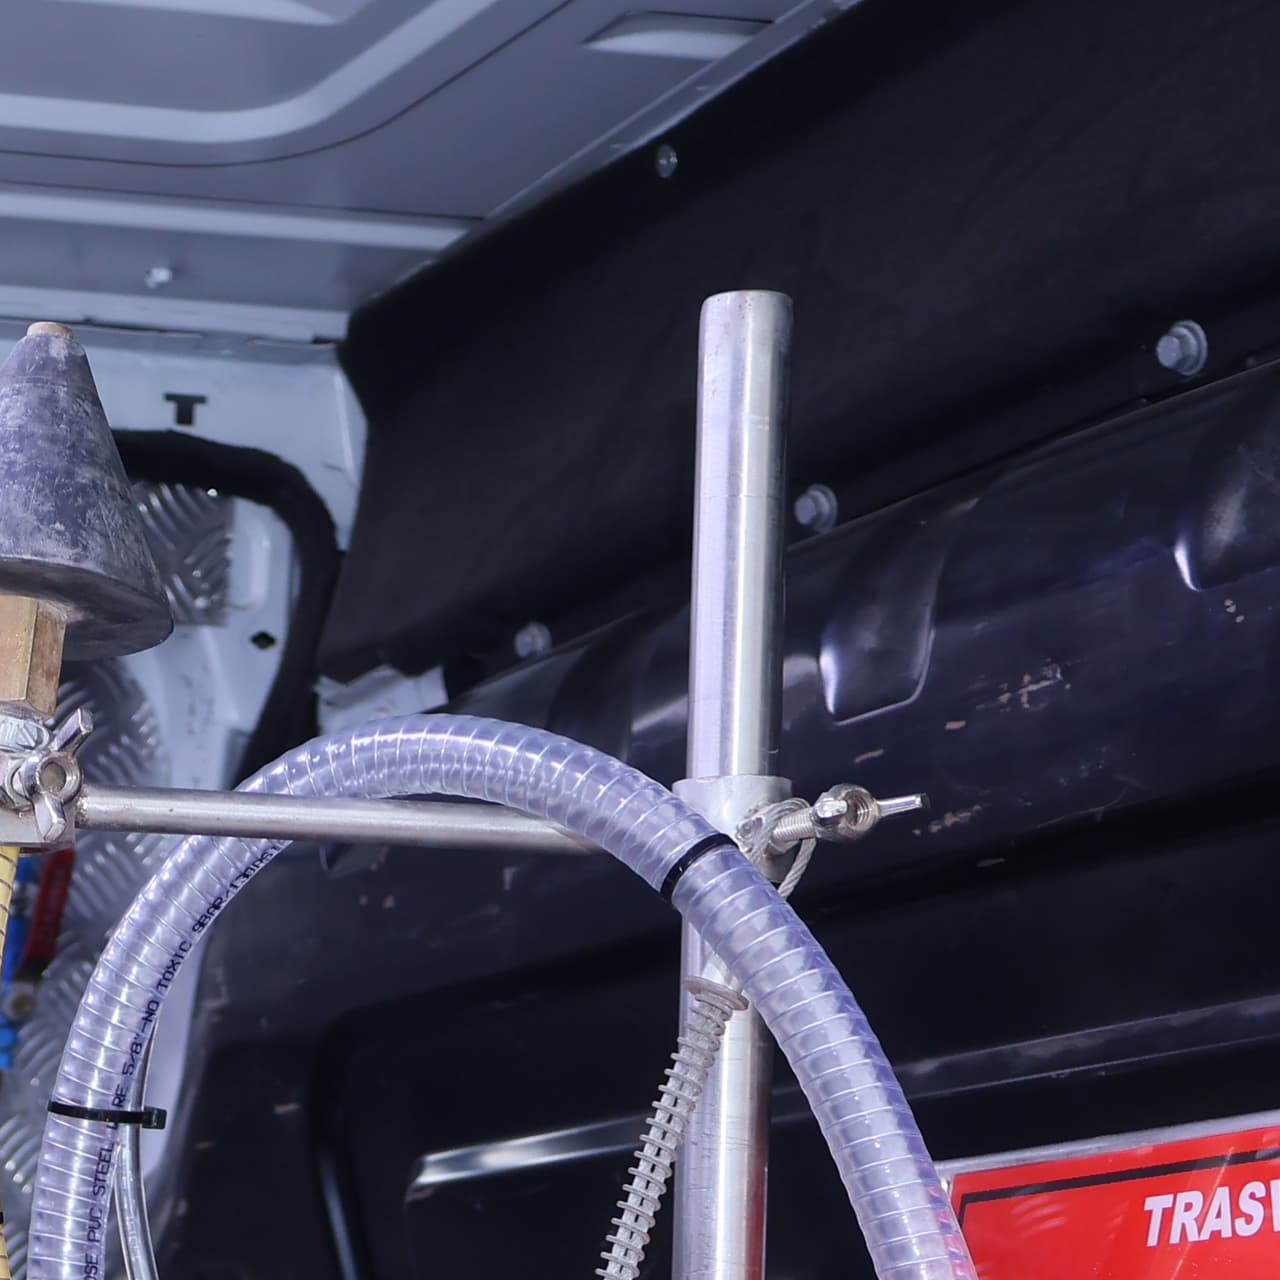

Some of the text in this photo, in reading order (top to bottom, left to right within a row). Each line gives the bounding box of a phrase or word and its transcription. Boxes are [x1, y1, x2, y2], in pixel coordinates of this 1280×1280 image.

[156, 940, 192, 992] TOXIC
[92, 1143, 114, 1197] STEEL
[87, 1207, 103, 1243] PVC
